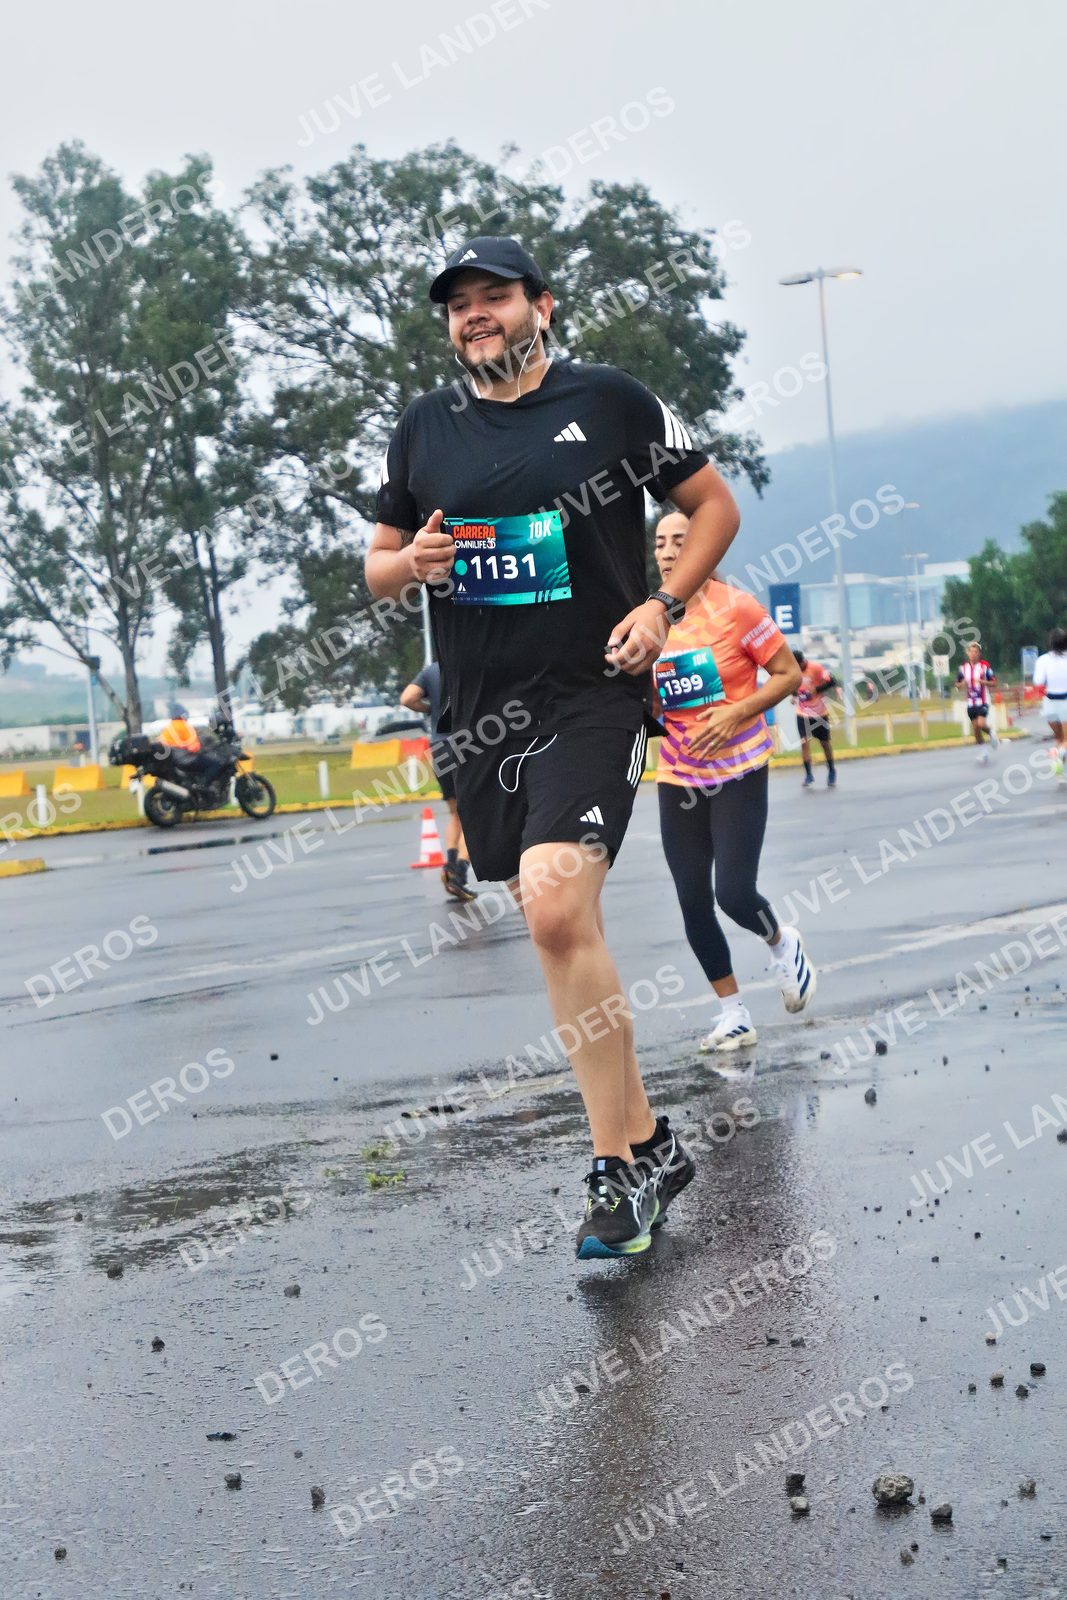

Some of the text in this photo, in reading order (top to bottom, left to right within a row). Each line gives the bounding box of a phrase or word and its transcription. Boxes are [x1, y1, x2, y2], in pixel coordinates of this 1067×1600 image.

[453, 525, 496, 539] CARRERA
[529, 519, 552, 540] 10K
[454, 540, 486, 549] OMNILIFE
[470, 553, 537, 580] 1131
[775, 605, 794, 630] E
[664, 674, 704, 696] 1399
